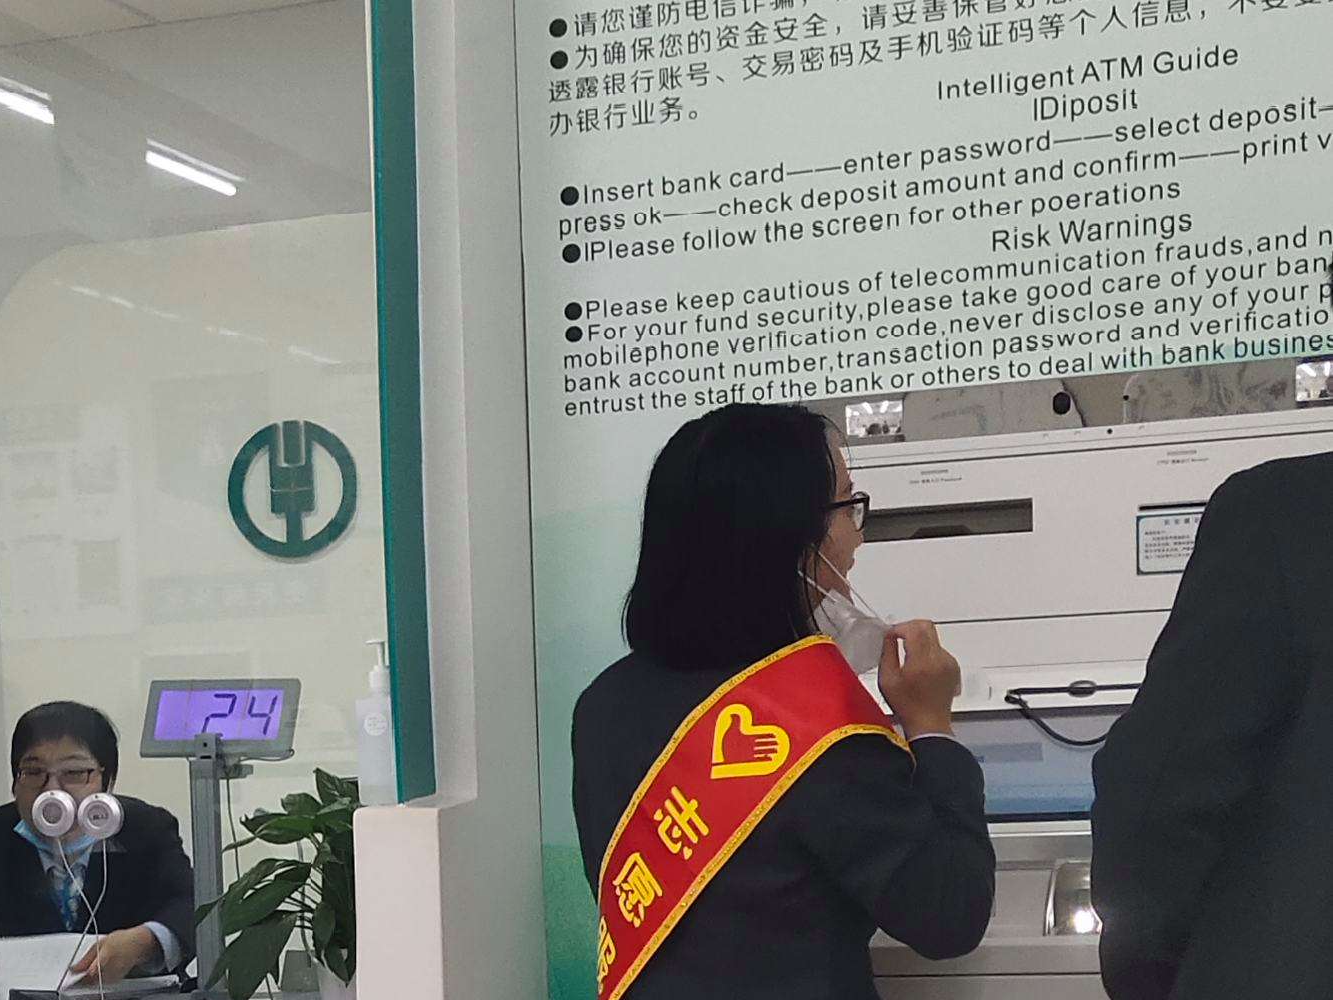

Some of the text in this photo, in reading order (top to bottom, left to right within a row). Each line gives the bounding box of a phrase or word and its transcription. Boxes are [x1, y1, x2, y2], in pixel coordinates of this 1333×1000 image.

[548, 0, 1333, 103] 透露银行账号、交易密码及手机验证码等个人信息，不
[575, 0, 1071, 69] 为确保您的资金安全，请妥善保管
[938, 45, 1238, 100] Intelligent ATM Guide
[549, 97, 699, 137] 办银行业务。
[560, 214, 625, 241] press
[801, 180, 897, 211] deposit
[906, 167, 1006, 197] amount
[1015, 159, 1063, 185] and
[584, 179, 654, 204] Insert
[662, 170, 721, 195] bank
[683, 229, 756, 251] follow
[765, 220, 803, 243] the
[812, 214, 899, 237] screen
[909, 206, 944, 225] for
[953, 199, 1022, 220] other
[1032, 182, 1180, 217] poerations
[993, 214, 1192, 252] Risk Warnings
[586, 299, 667, 319] Please
[677, 292, 734, 311] keep
[744, 280, 849, 304] cautious
[859, 271, 883, 292] of
[891, 248, 1144, 289] telecommunication
[588, 324, 627, 341] For
[635, 321, 688, 342] your
[695, 310, 747, 333] fund
[962, 286, 1017, 307] take
[1027, 276, 1091, 306] good
[1102, 274, 1160, 293] care
[1171, 265, 1197, 287] of
[1206, 263, 1267, 289] your
[564, 340, 719, 369] mobilephone
[1033, 301, 1144, 326] disclose
[1154, 295, 1202, 316] any
[1213, 286, 1238, 308] of
[1246, 285, 1309, 311] your
[565, 371, 620, 392] bank
[629, 362, 725, 387] account
[993, 324, 1120, 360] password
[1131, 318, 1179, 340] and
[565, 393, 644, 416] entrust
[651, 390, 686, 409] the
[695, 383, 745, 406] staff
[753, 380, 774, 399] of
[780, 379, 816, 397] the
[825, 372, 883, 394] bank
[891, 373, 914, 388] or
[922, 365, 999, 385] others
[1009, 360, 1030, 377] to
[1040, 352, 1092, 375] deal
[1101, 345, 1152, 369] with
[1162, 339, 1224, 364] bank
[202, 694, 278, 736] 24
